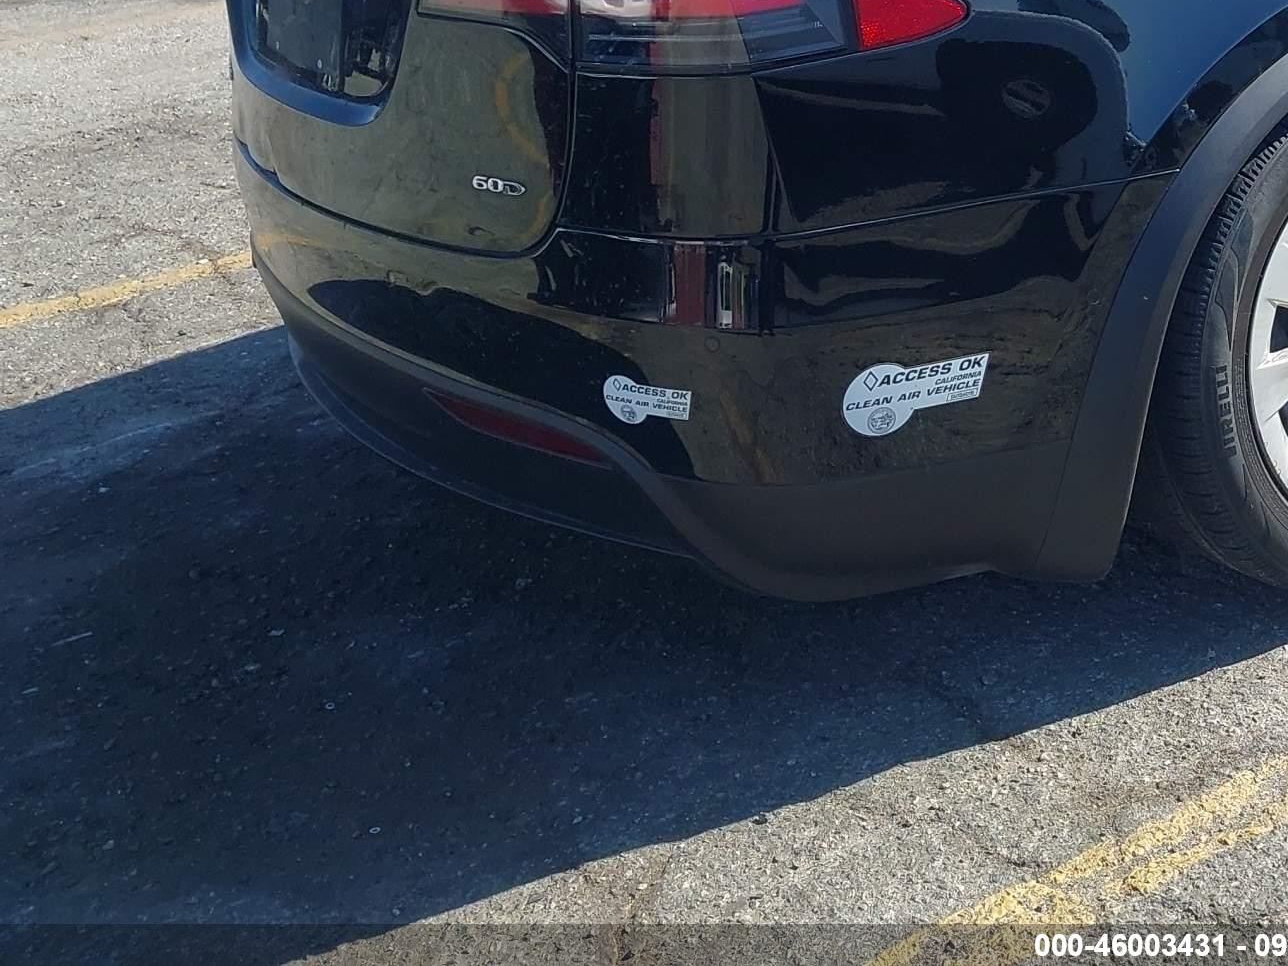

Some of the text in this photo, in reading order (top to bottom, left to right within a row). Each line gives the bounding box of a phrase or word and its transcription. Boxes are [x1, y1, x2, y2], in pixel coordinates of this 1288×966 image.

[472, 175, 526, 196] 60D
[877, 355, 985, 388] ACCESS OK
[934, 370, 982, 386] CALIFORNIA
[621, 383, 689, 401] ACCESS OK
[845, 395, 893, 412] CLEAN
[897, 390, 922, 402] AIR
[926, 378, 982, 397] VEHICLE
[605, 394, 633, 404] CLEAN
[652, 403, 688, 413] VEHICLE
[656, 398, 688, 407] CALIFORNIA
